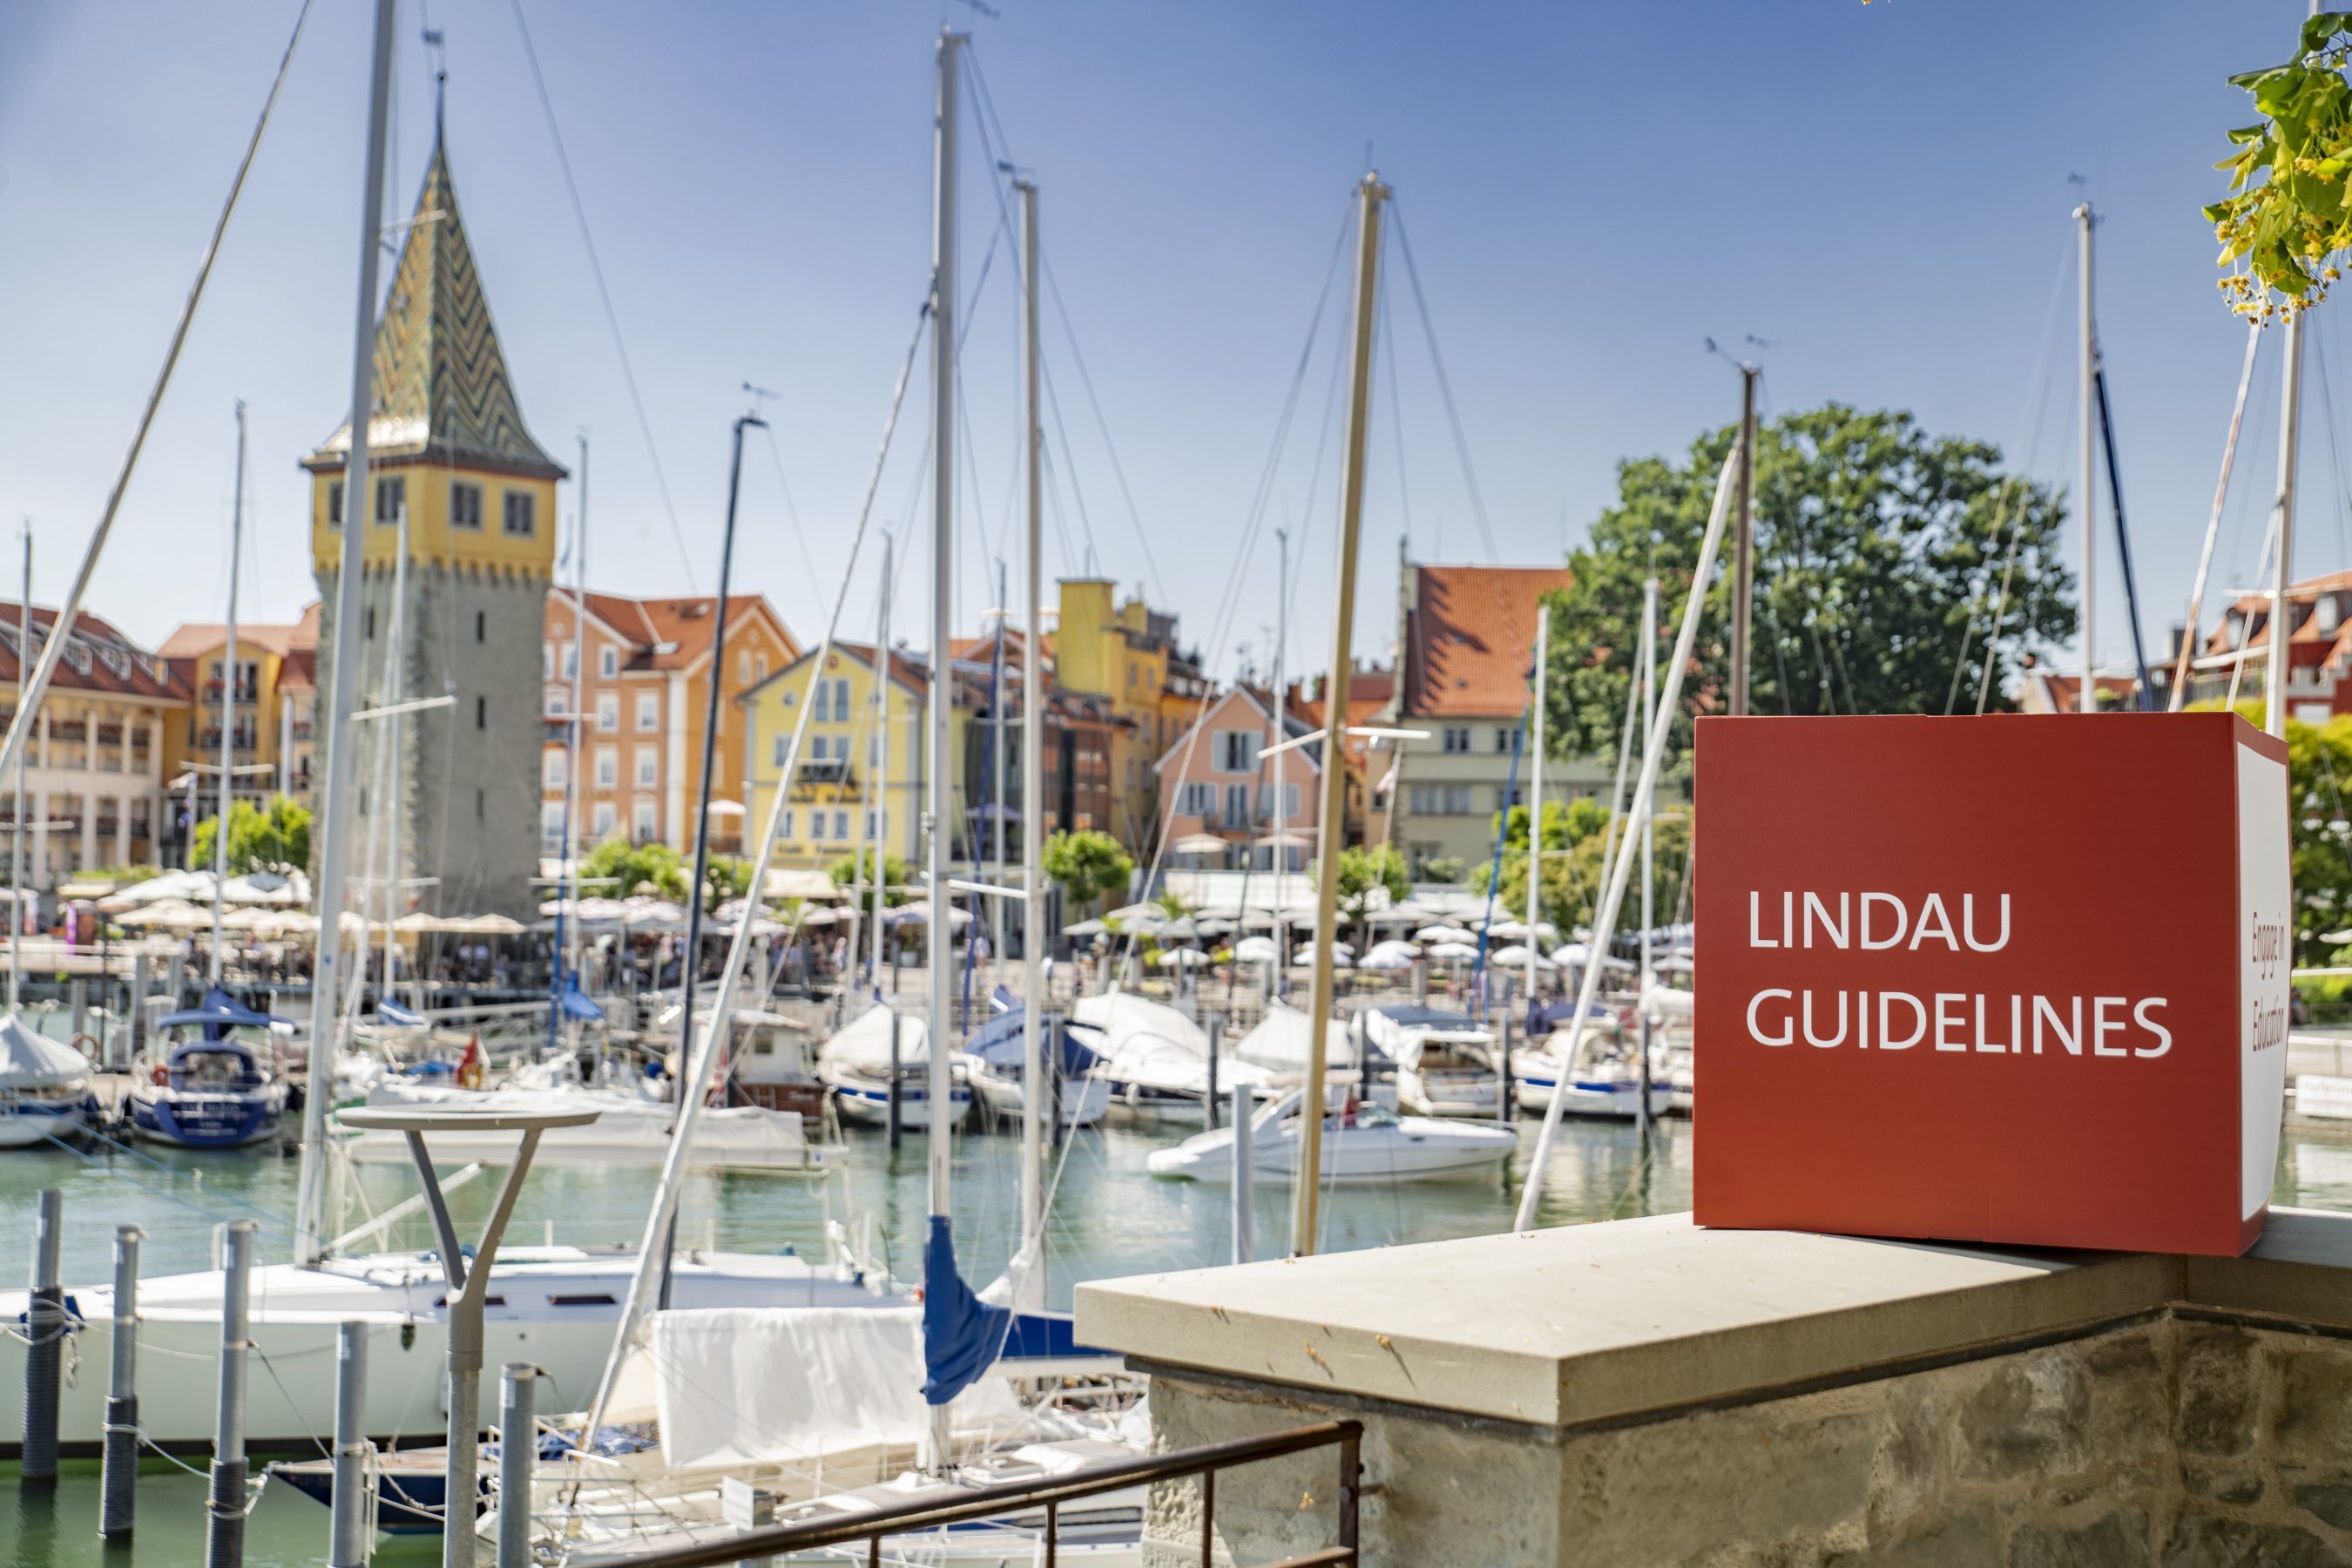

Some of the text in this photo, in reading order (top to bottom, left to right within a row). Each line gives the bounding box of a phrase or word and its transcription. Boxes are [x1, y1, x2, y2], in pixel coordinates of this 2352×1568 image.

[1749, 890, 2011, 952] LINDAU
[2252, 910, 2285, 980] Engage in
[1746, 988, 2173, 1058] GUIDELINES
[2253, 994, 2284, 1051] Education
